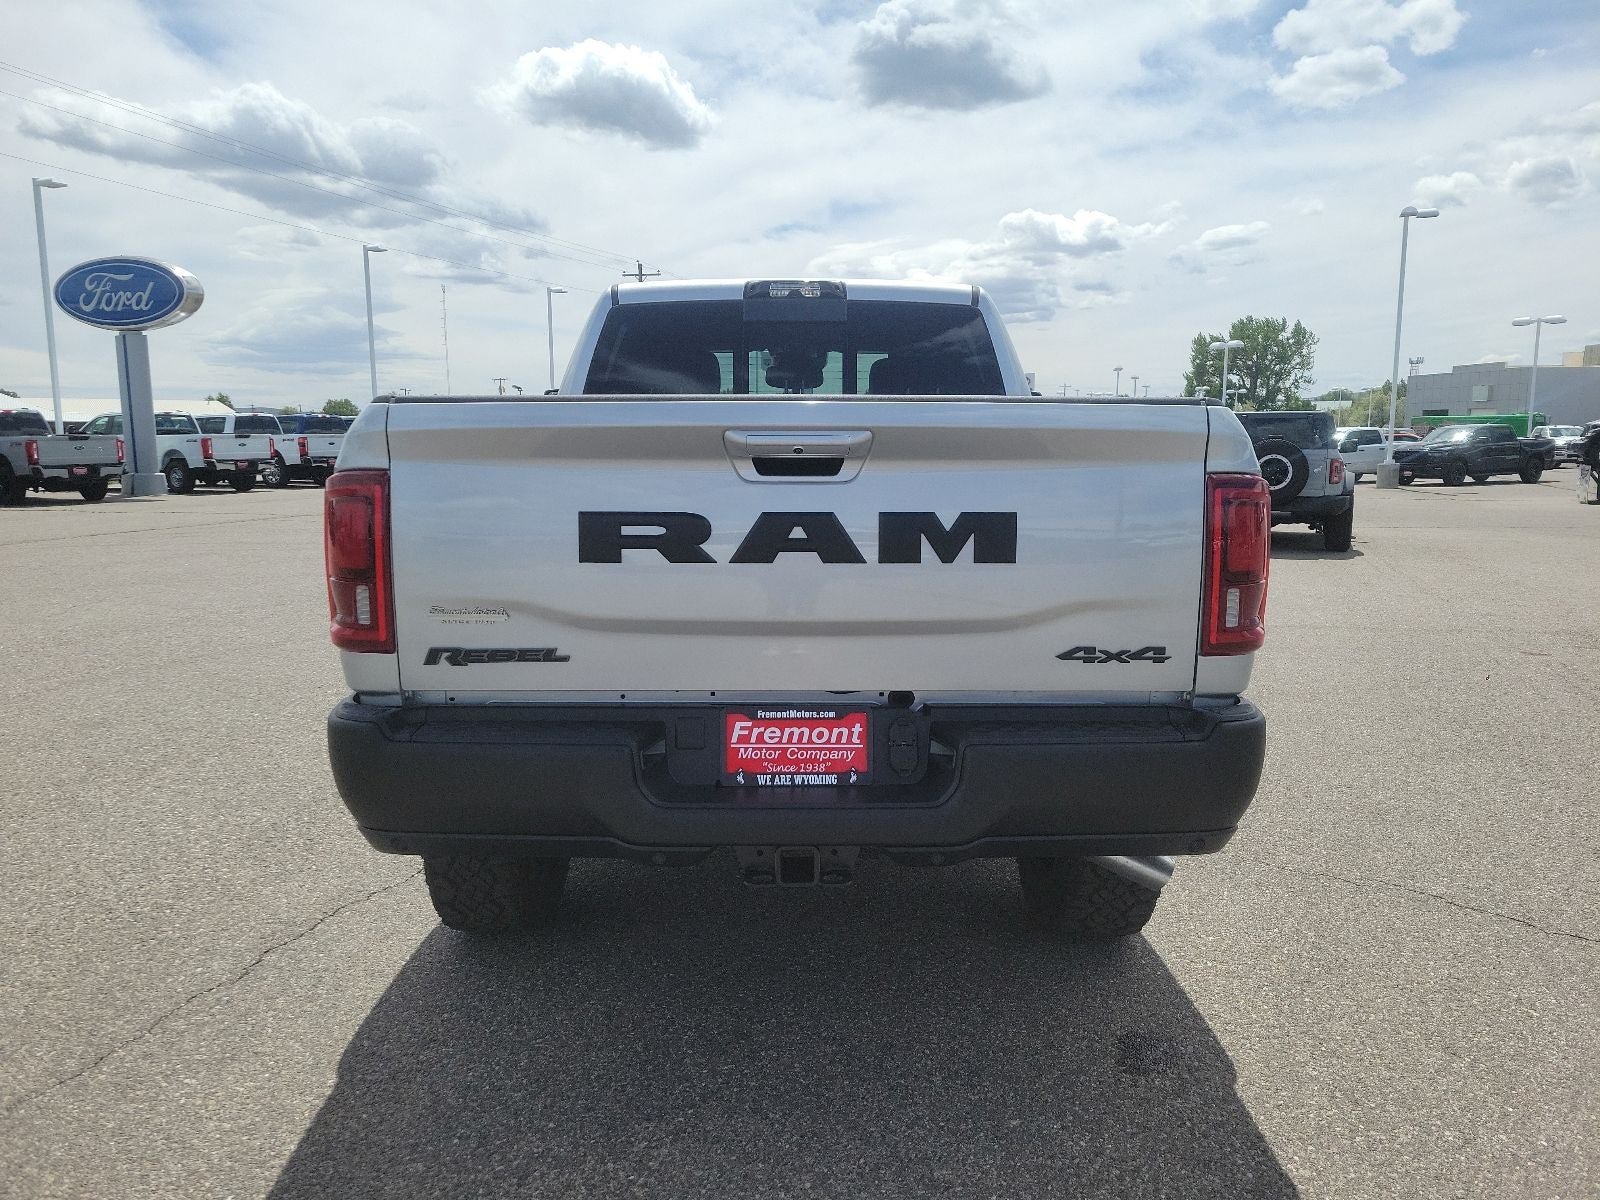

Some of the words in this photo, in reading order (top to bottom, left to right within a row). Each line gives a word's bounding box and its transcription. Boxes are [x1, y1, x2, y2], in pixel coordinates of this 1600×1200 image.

[79, 272, 155, 312] Ford
[578, 511, 1018, 564] RAM
[423, 646, 571, 667] REBEL
[1054, 646, 1173, 664] 4x4
[757, 710, 836, 719] FremontMotors.com
[730, 721, 863, 744] Fremont
[738, 747, 782, 759] Motor
[786, 747, 856, 762] Company
[757, 774, 771, 786] WE
[773, 774, 792, 785] ARE
[794, 774, 838, 785] WYOMING
